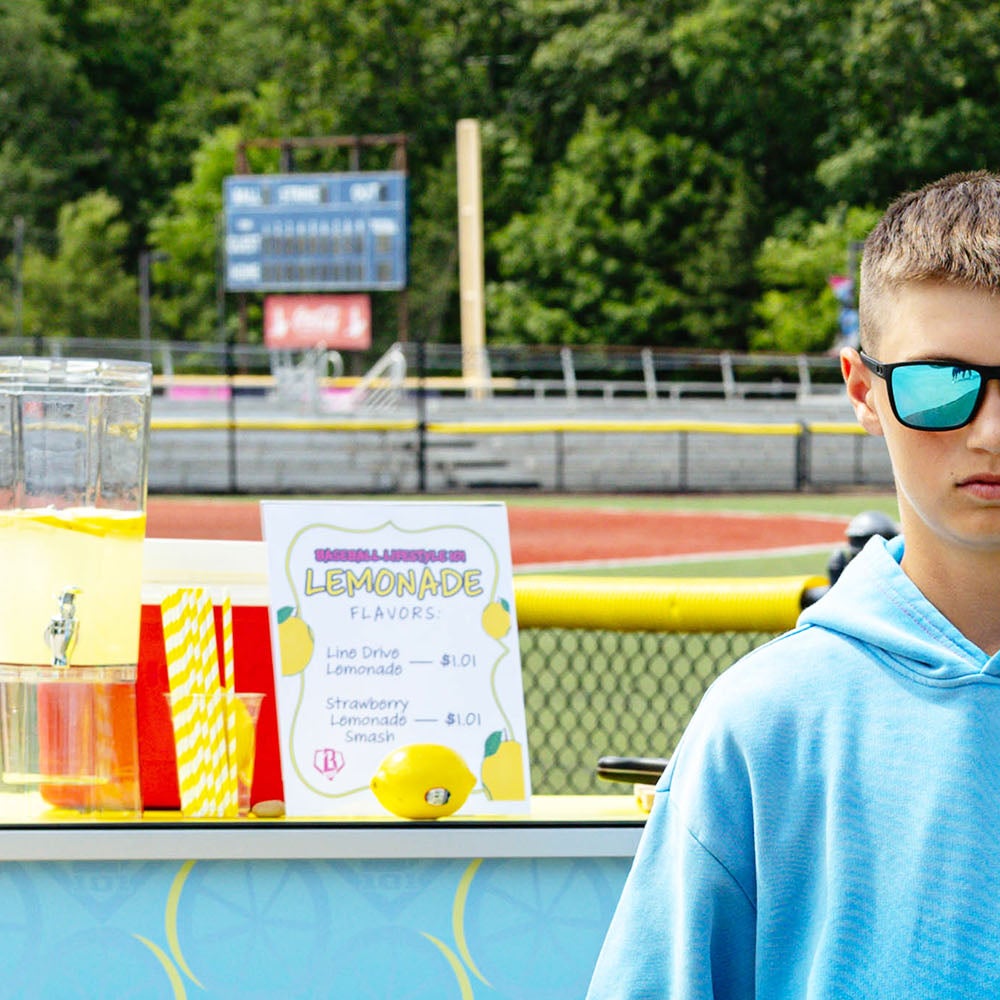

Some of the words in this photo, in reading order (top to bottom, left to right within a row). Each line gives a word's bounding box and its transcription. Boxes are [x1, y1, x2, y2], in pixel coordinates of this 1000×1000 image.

[305, 567, 483, 602] LEMONADE
[350, 606, 440, 621] FLAVORS:
[327, 646, 357, 659] Line
[362, 646, 400, 659] Drive
[440, 654, 476, 667] $1.01
[326, 663, 403, 676] Lemonade
[325, 697, 409, 713] Strawberry
[330, 713, 407, 726] Lemonade
[445, 712, 481, 726] $1.01
[345, 730, 395, 743] Smash
